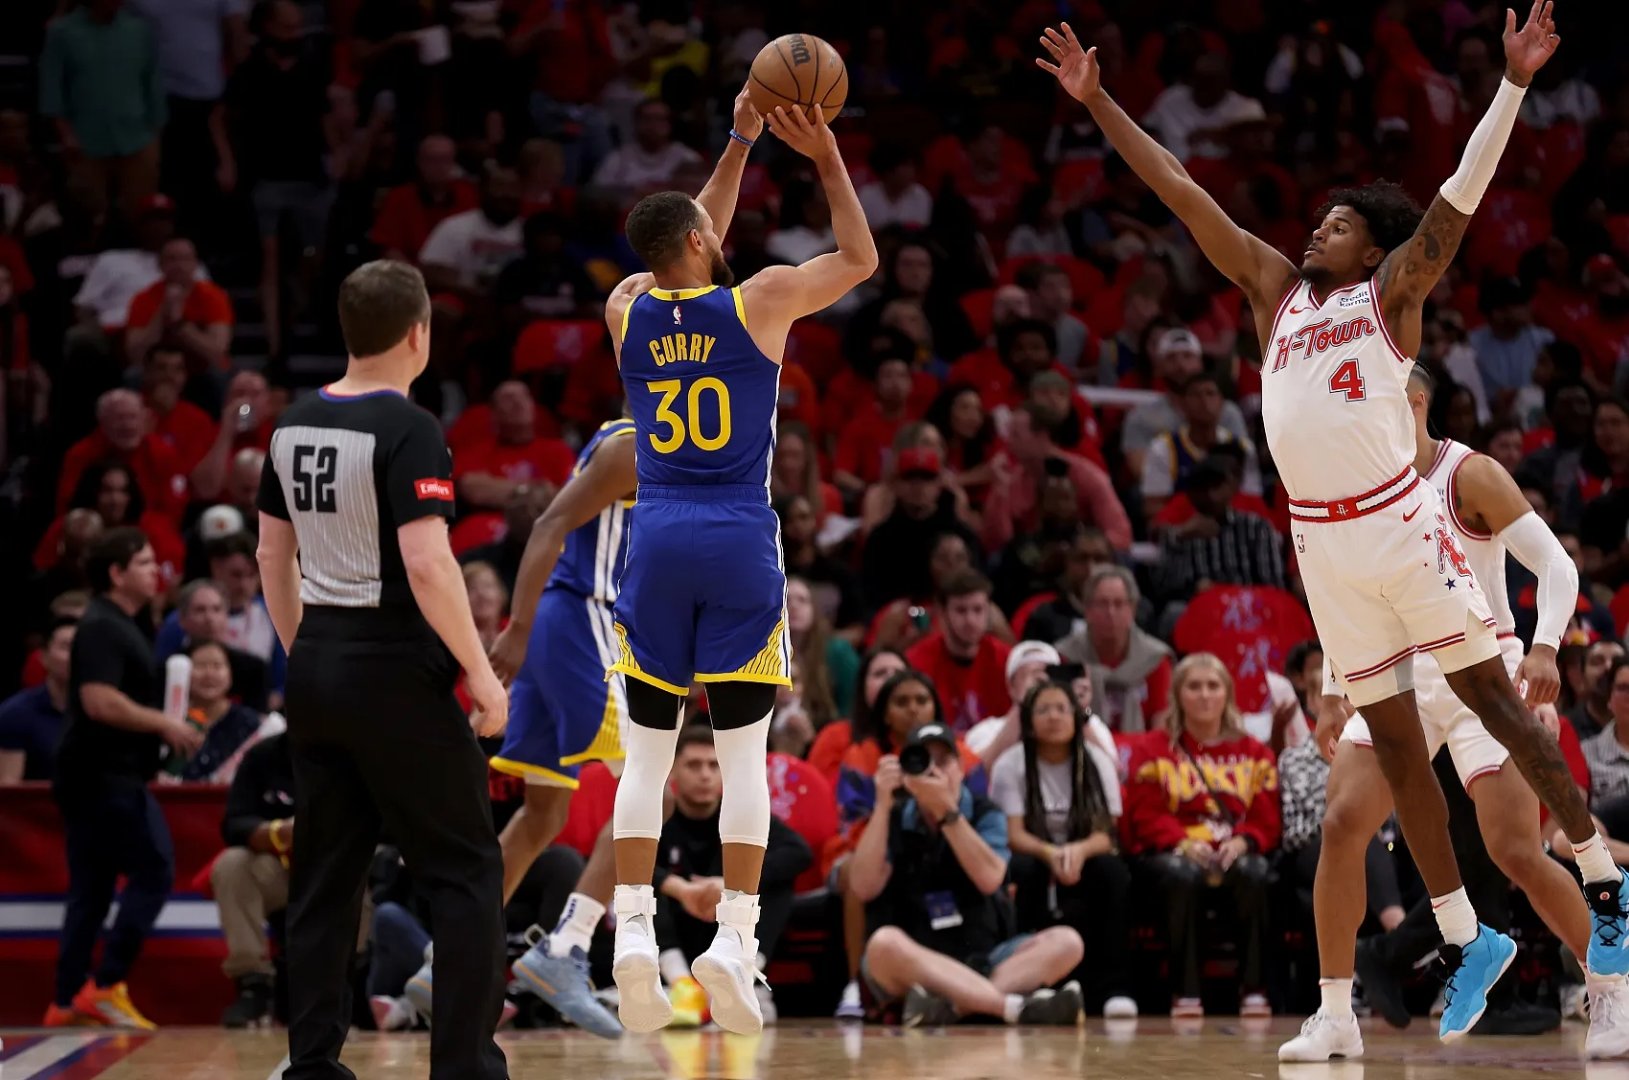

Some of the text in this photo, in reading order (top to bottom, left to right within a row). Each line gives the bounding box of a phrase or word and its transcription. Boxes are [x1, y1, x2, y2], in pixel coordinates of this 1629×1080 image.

[649, 332, 717, 367] CURRY
[1271, 316, 1376, 374] H-Town
[1327, 358, 1367, 402] 4
[646, 376, 732, 454] 30
[293, 445, 338, 513] 52
